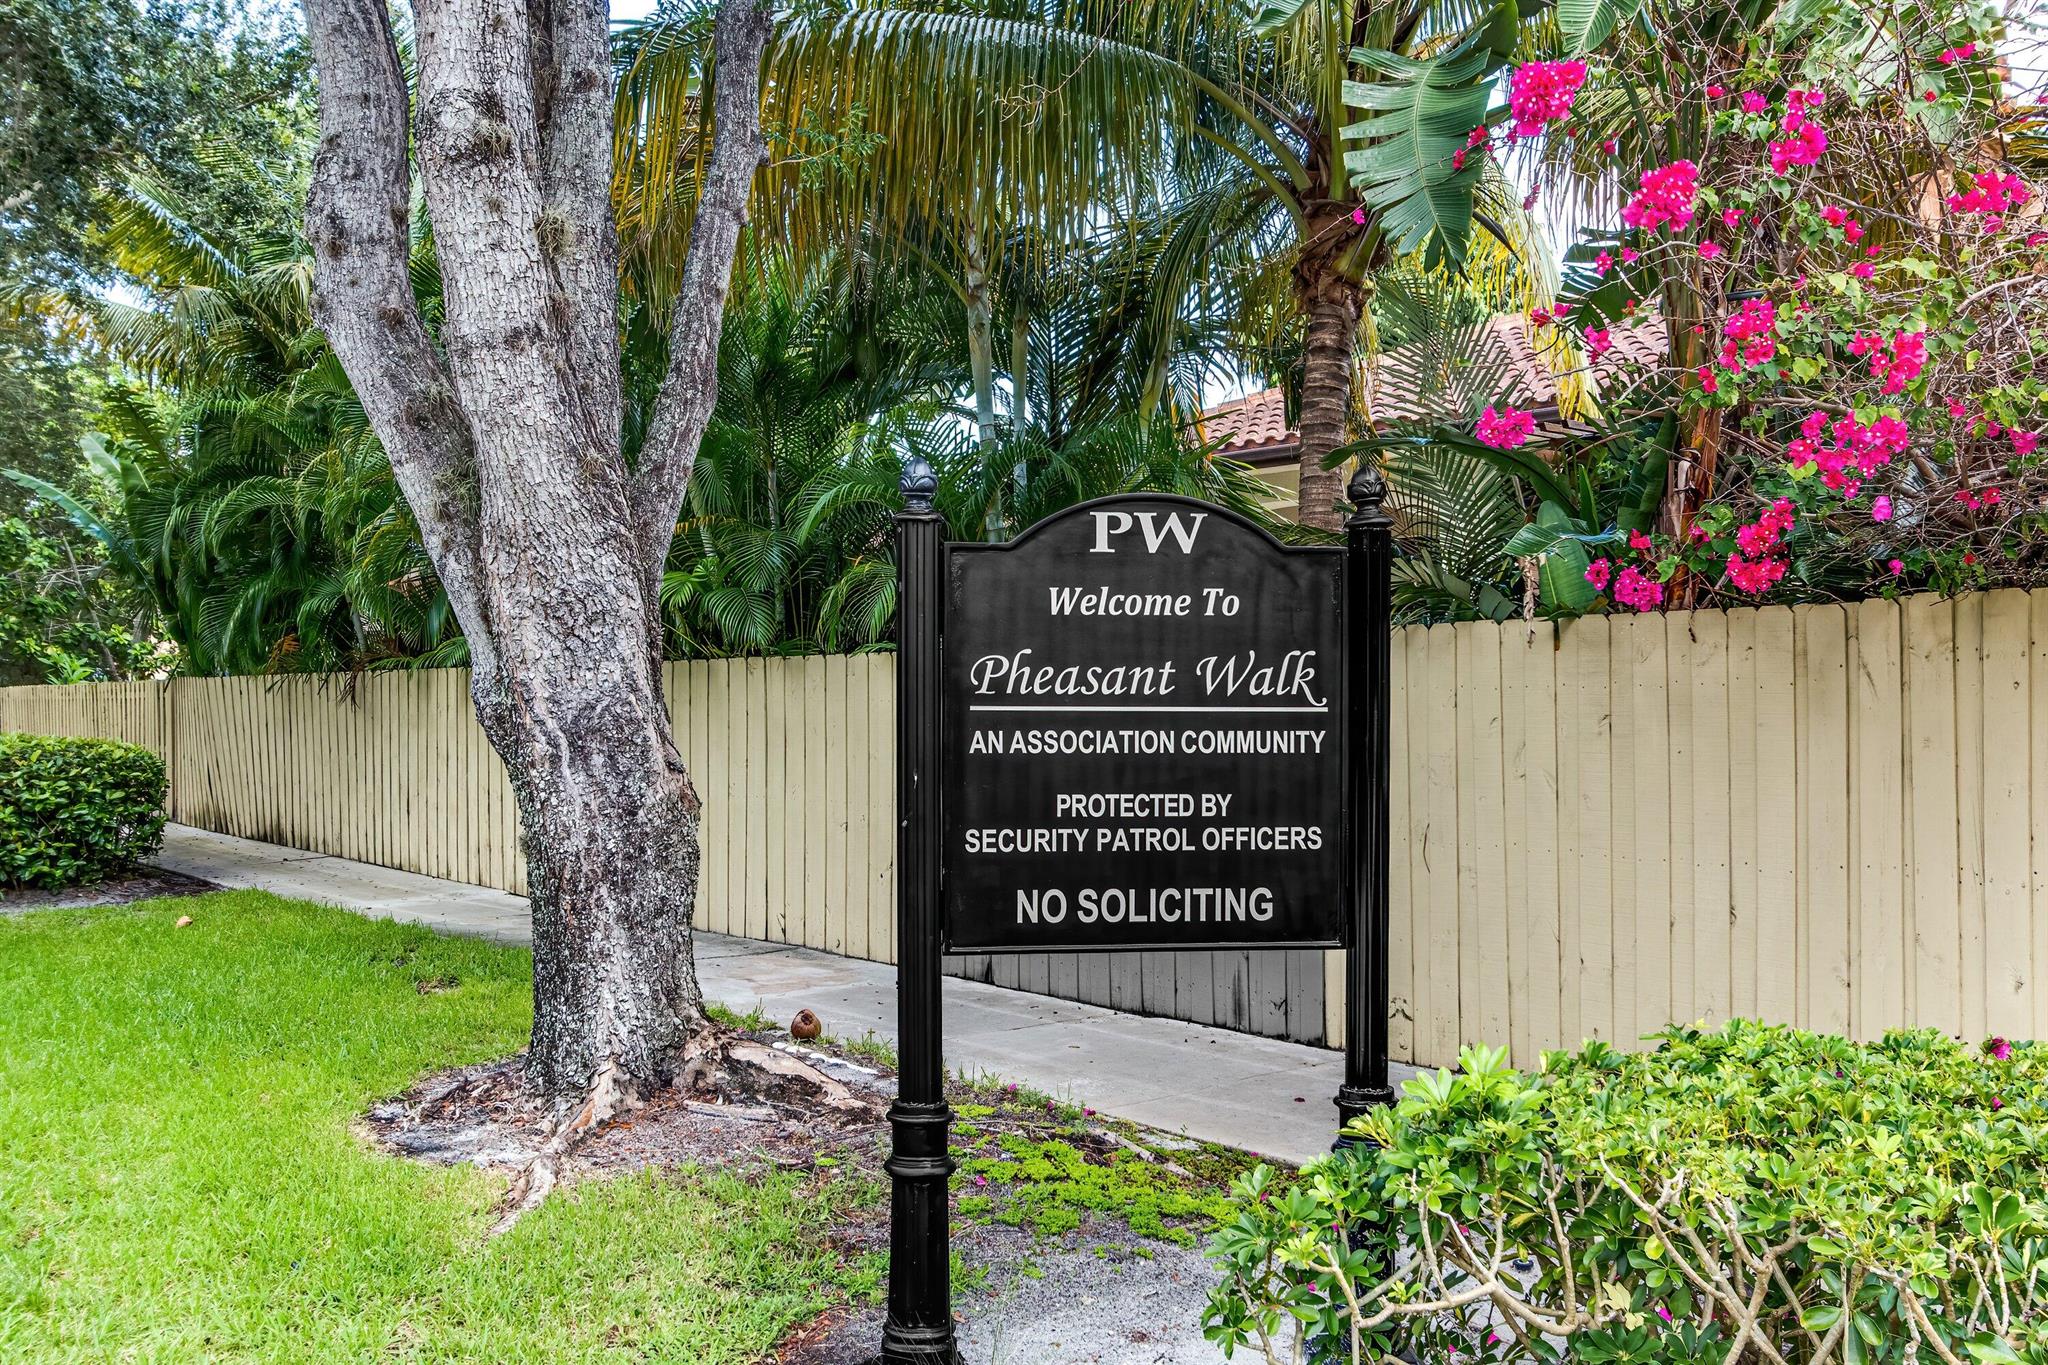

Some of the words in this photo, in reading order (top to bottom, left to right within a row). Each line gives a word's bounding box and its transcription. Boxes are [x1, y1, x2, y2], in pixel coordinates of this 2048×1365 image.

[1090, 512, 1208, 554] PW
[1049, 586, 1191, 616] Welcome
[1203, 588, 1239, 616] To
[971, 649, 1176, 695] Pheasant
[1196, 650, 1327, 706] Walk
[969, 731, 1003, 753] AN
[1009, 730, 1174, 754] ASSOCIATION
[1181, 730, 1326, 754] COMMUNITY
[1057, 794, 1194, 817] PROTECTED
[1202, 794, 1232, 816] BY
[965, 829, 1089, 852] SECURITY
[1097, 828, 1195, 851] PATROL
[1203, 827, 1322, 850] OFFICERS
[1017, 889, 1067, 923] NO
[1078, 888, 1273, 923] SOLICITING
